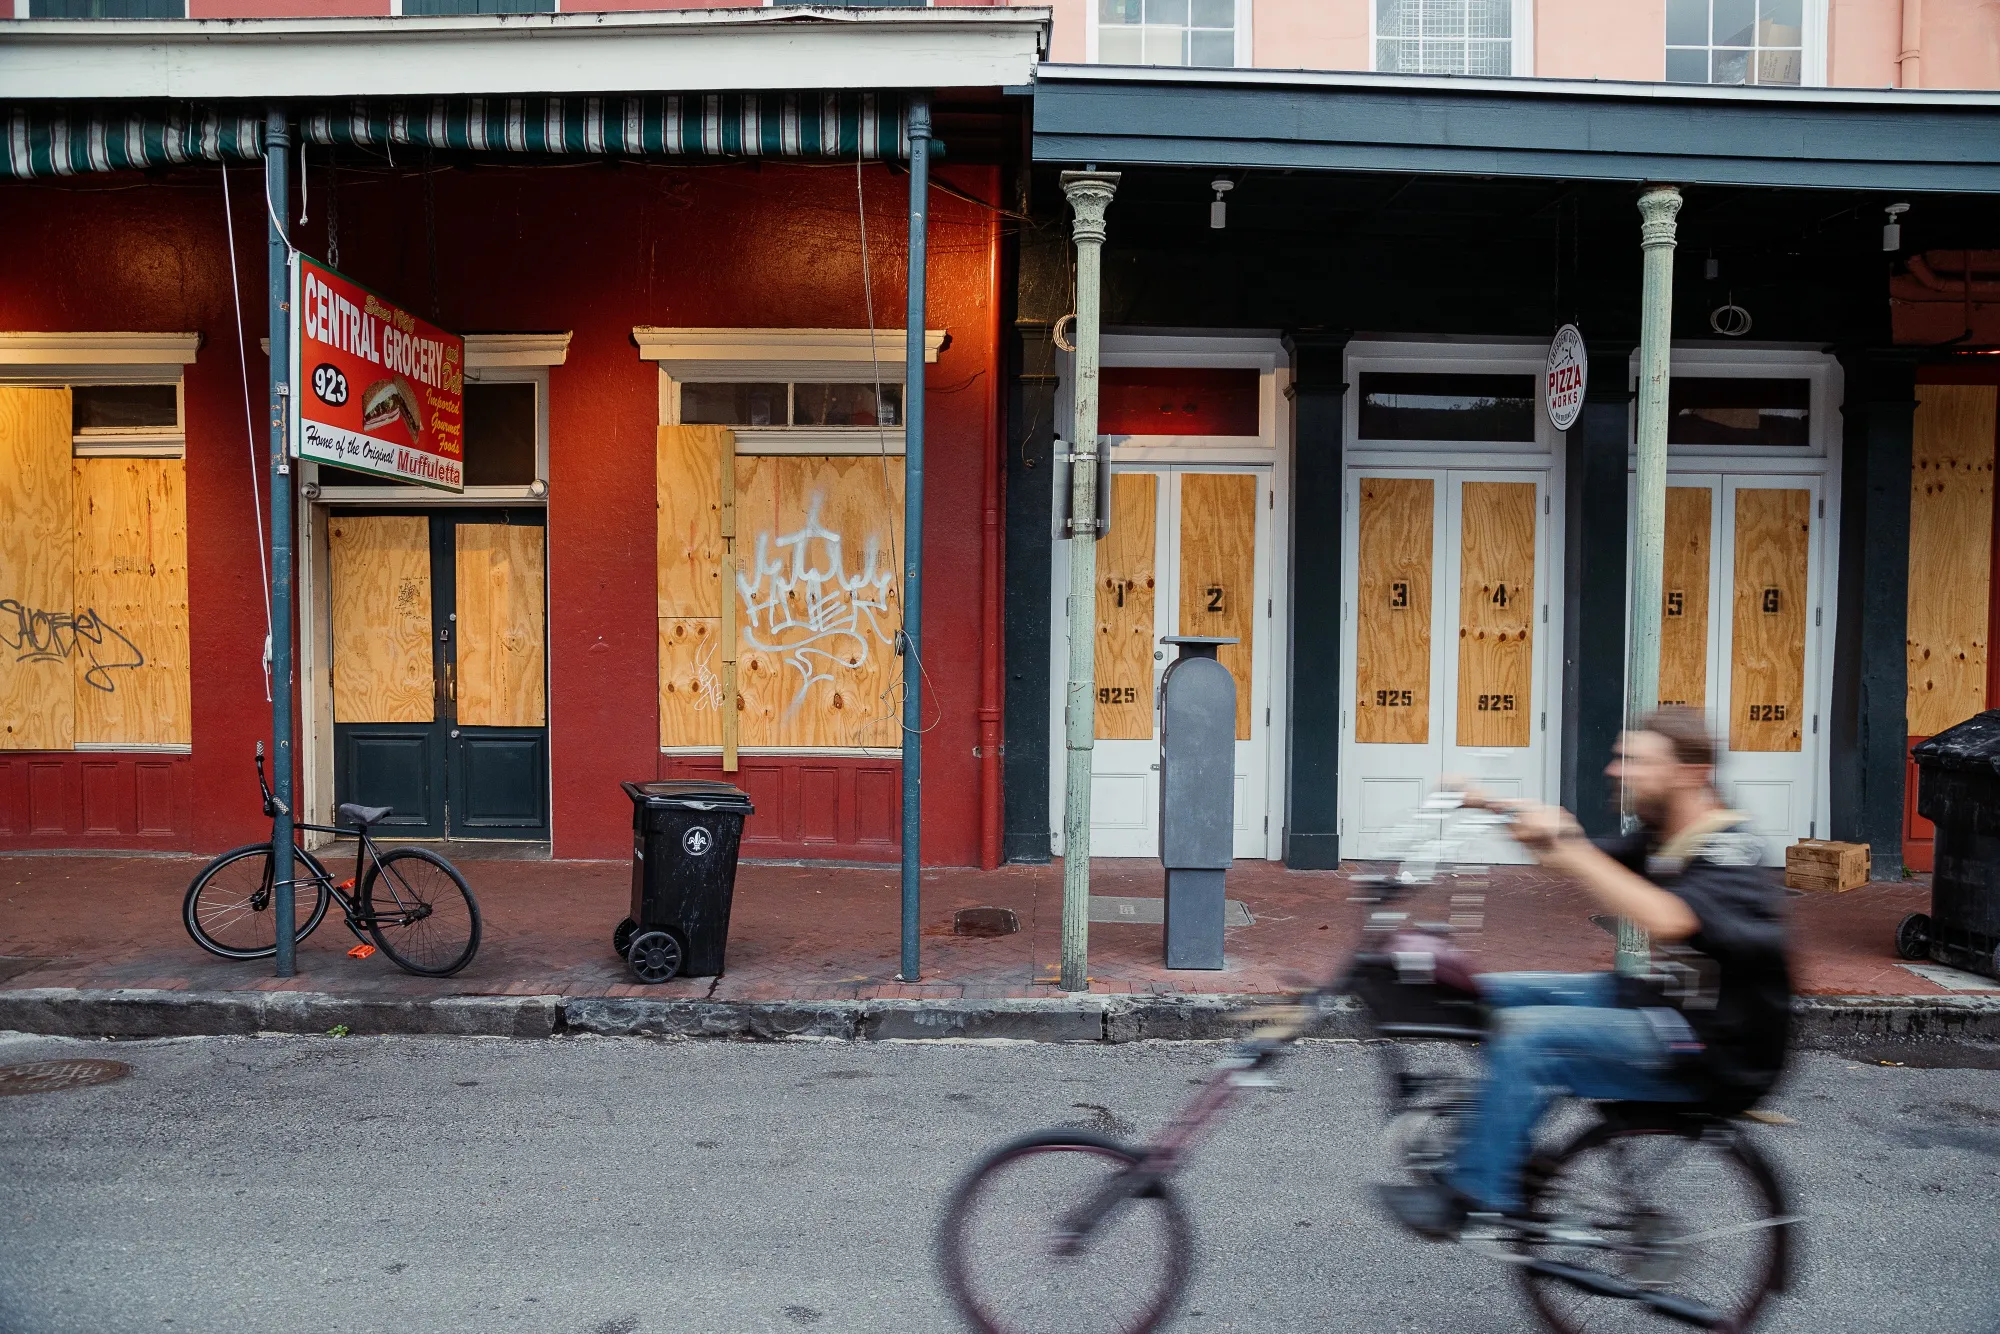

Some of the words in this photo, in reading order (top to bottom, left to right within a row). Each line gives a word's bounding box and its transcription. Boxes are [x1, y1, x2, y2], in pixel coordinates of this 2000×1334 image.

[364, 295, 391, 322] Since
[305, 272, 380, 364] CENTRAL
[383, 325, 443, 388] GROCERY
[446, 345, 459, 364] and
[315, 367, 347, 403] 923
[1549, 364, 1582, 396] PIZZA
[426, 388, 460, 415] Imported
[1552, 392, 1578, 409] WORKS
[431, 411, 461, 437] Gourmet
[306, 425, 333, 449] Home
[335, 435, 346, 459] of
[347, 436, 360, 456] the
[362, 440, 394, 467] Original
[397, 448, 461, 486] Muffuletta
[438, 433, 460, 454] Foods
[1117, 583, 1124, 608] 1
[1206, 588, 1223, 613] 2
[1392, 583, 1407, 607] 3
[1492, 583, 1507, 607] 4
[1667, 592, 1683, 616] 5
[1099, 687, 1135, 704] 925
[1376, 690, 1412, 706] 925
[1478, 694, 1514, 711] 925
[1749, 704, 1785, 721] 925
